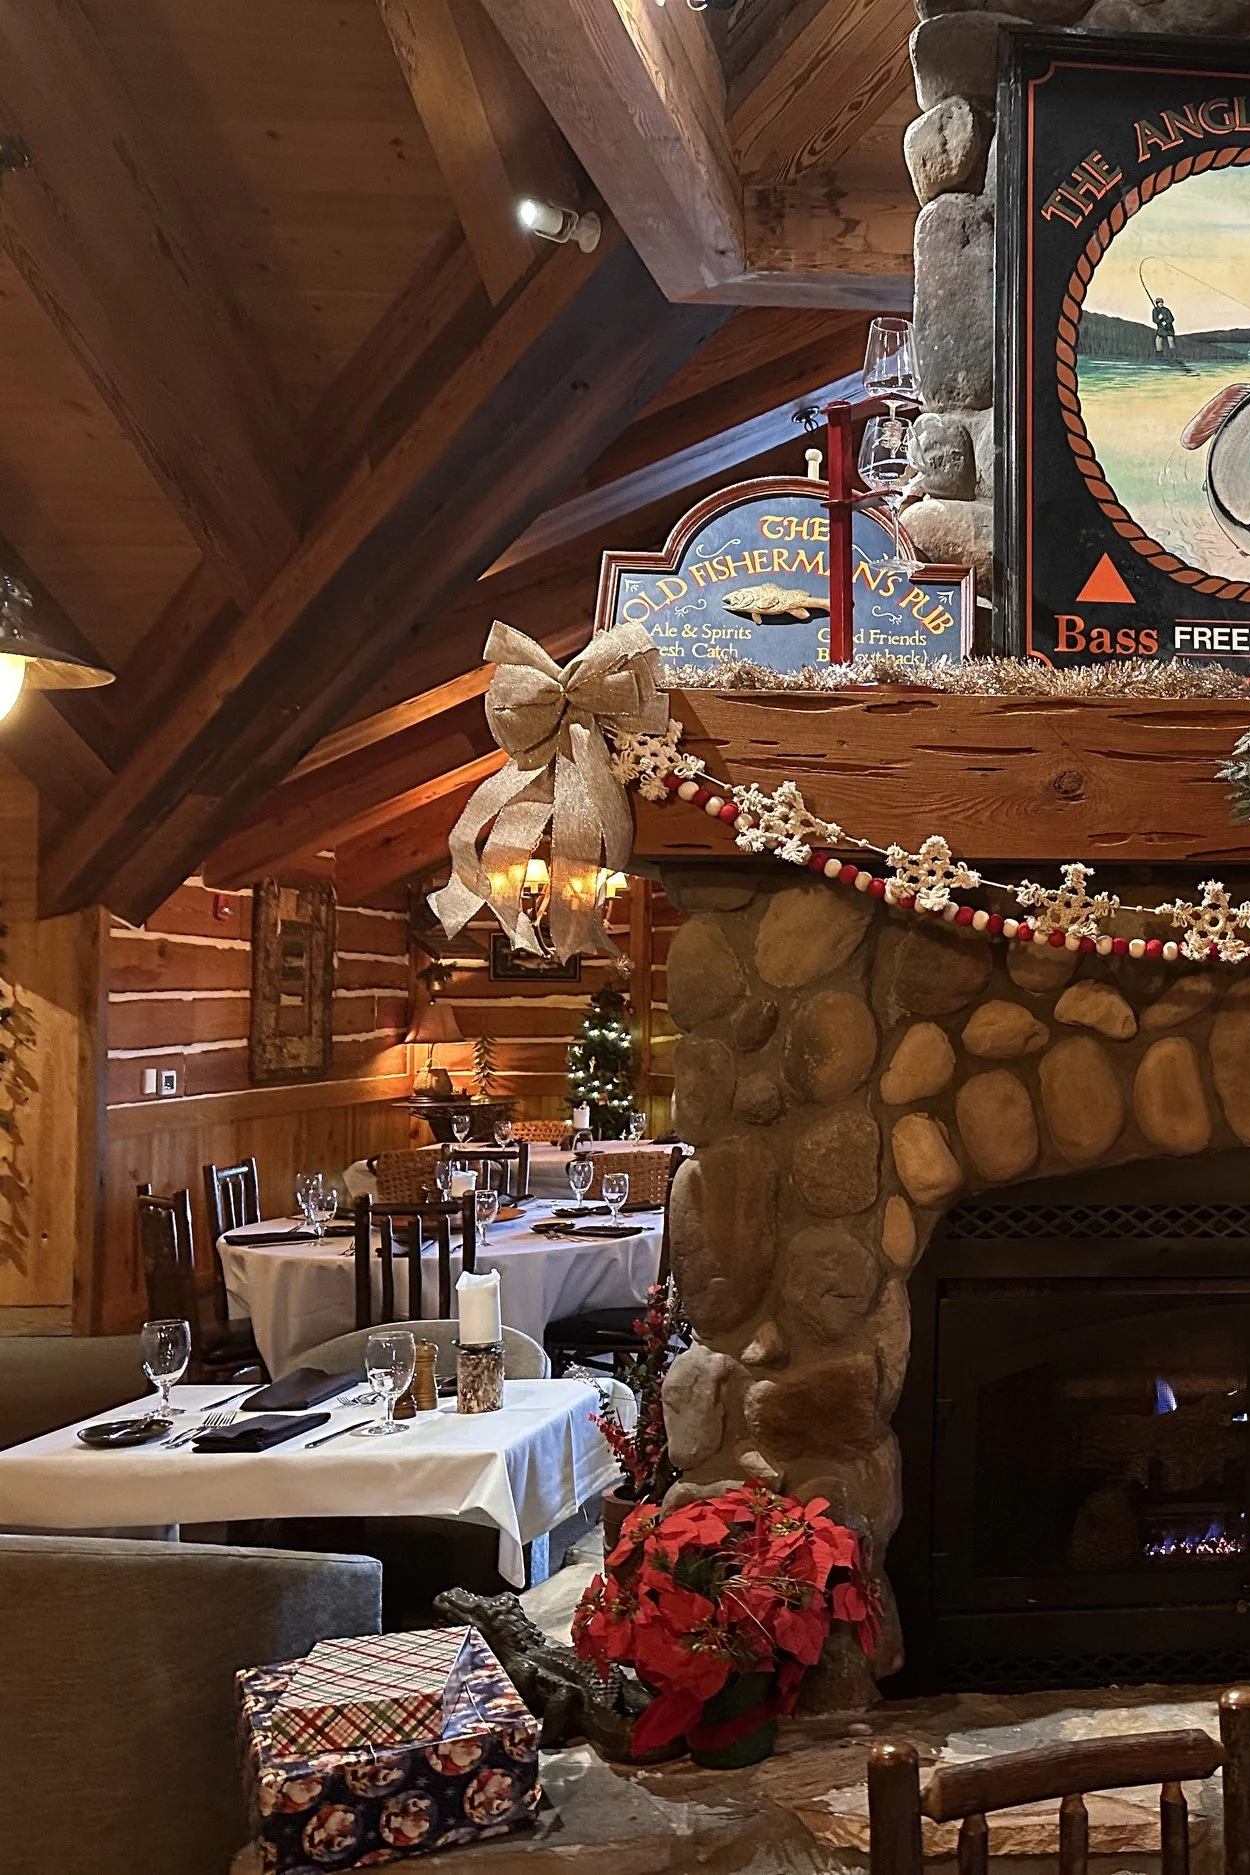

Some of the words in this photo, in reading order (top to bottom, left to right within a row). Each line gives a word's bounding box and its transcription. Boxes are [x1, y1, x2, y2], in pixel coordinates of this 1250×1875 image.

[1041, 149, 1123, 229] THE
[759, 514, 830, 542] THE
[622, 577, 689, 624] OLD
[688, 547, 903, 598] FISHERMN'S
[896, 586, 955, 636] PUB
[651, 622, 678, 638] Ale
[681, 622, 697, 639] &
[701, 623, 752, 644] Spirits
[869, 629, 928, 646] Friends
[1053, 614, 1159, 655] Bass
[1174, 626, 1250, 651] FREE
[691, 642, 739, 660] Catch
